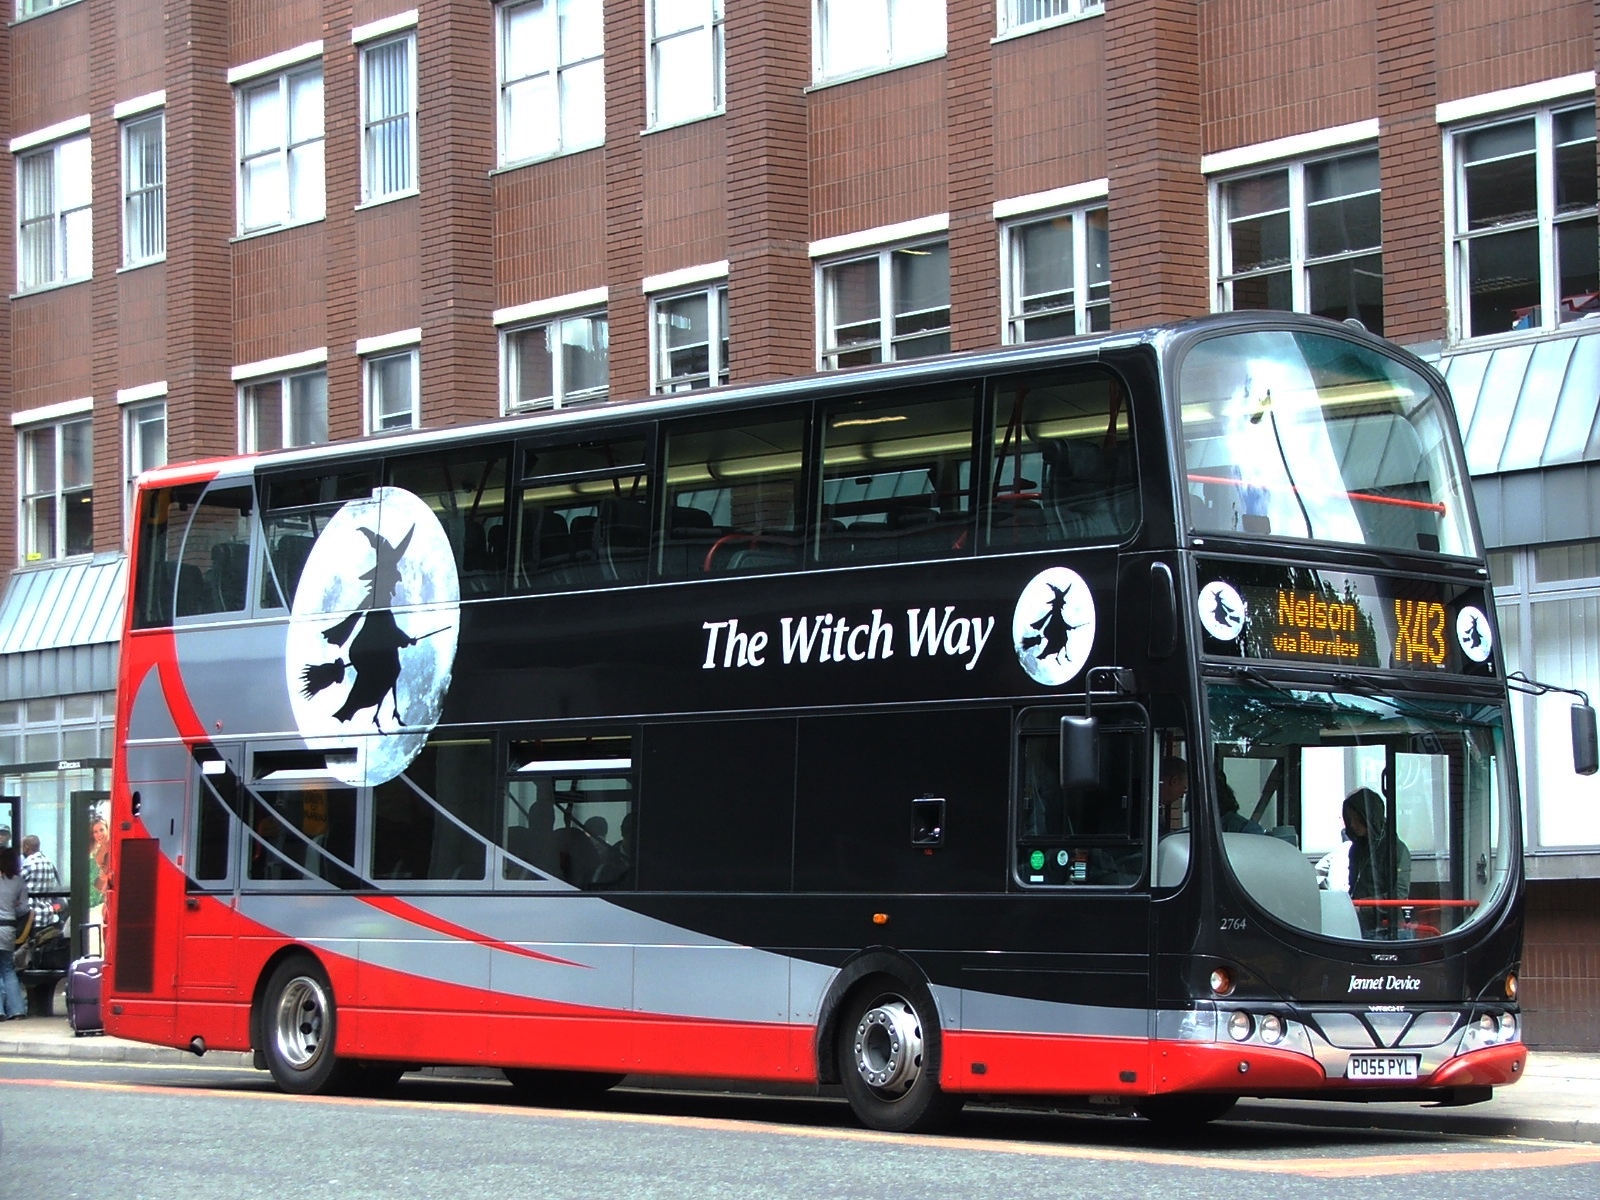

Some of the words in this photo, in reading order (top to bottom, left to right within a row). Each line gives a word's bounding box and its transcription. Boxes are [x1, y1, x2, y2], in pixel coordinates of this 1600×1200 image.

[1278, 591, 1355, 632] Nelson
[702, 618, 768, 669] The
[780, 608, 894, 664] Witch
[906, 605, 995, 671] Way
[1273, 633, 1297, 652] via
[1300, 631, 1359, 658] Burnley
[1395, 599, 1446, 664] X43
[1220, 918, 1247, 930] 2764
[1347, 975, 1384, 993] Jennet
[1385, 975, 1421, 990] Device
[1352, 1059, 1385, 1075] PO55
[1388, 1059, 1412, 1075] PYL
